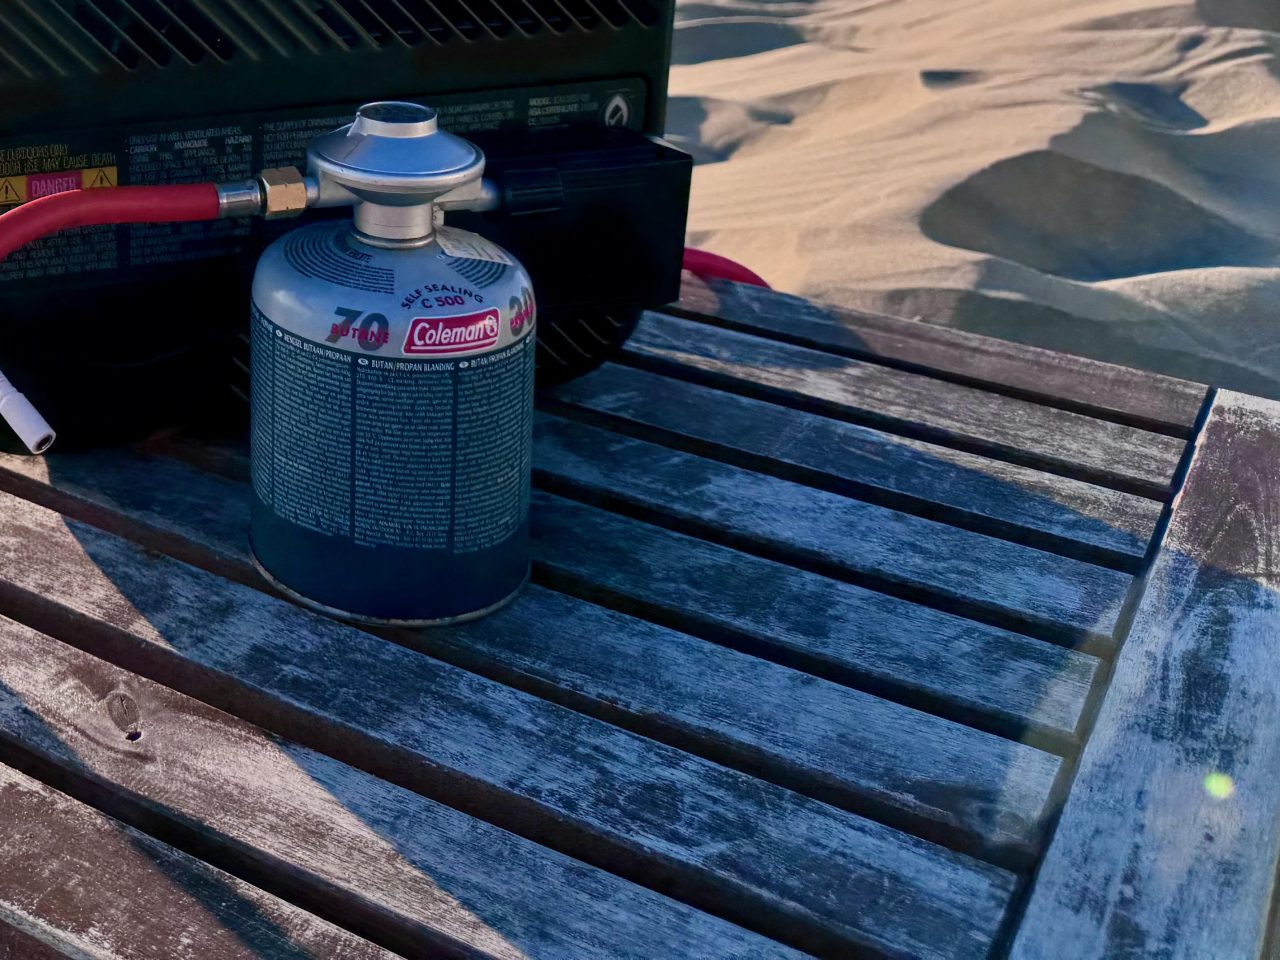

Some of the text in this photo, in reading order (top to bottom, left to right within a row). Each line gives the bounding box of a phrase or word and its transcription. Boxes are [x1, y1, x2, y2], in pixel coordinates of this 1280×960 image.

[31, 176, 76, 197] DANGER
[401, 283, 485, 310] SELF SEALING
[420, 295, 465, 309] C 500
[327, 305, 389, 351] 70
[331, 323, 389, 344] BUTANE
[413, 319, 485, 346] Coleman
[371, 359, 455, 372] BUTAN/PROPAN BLANDING
